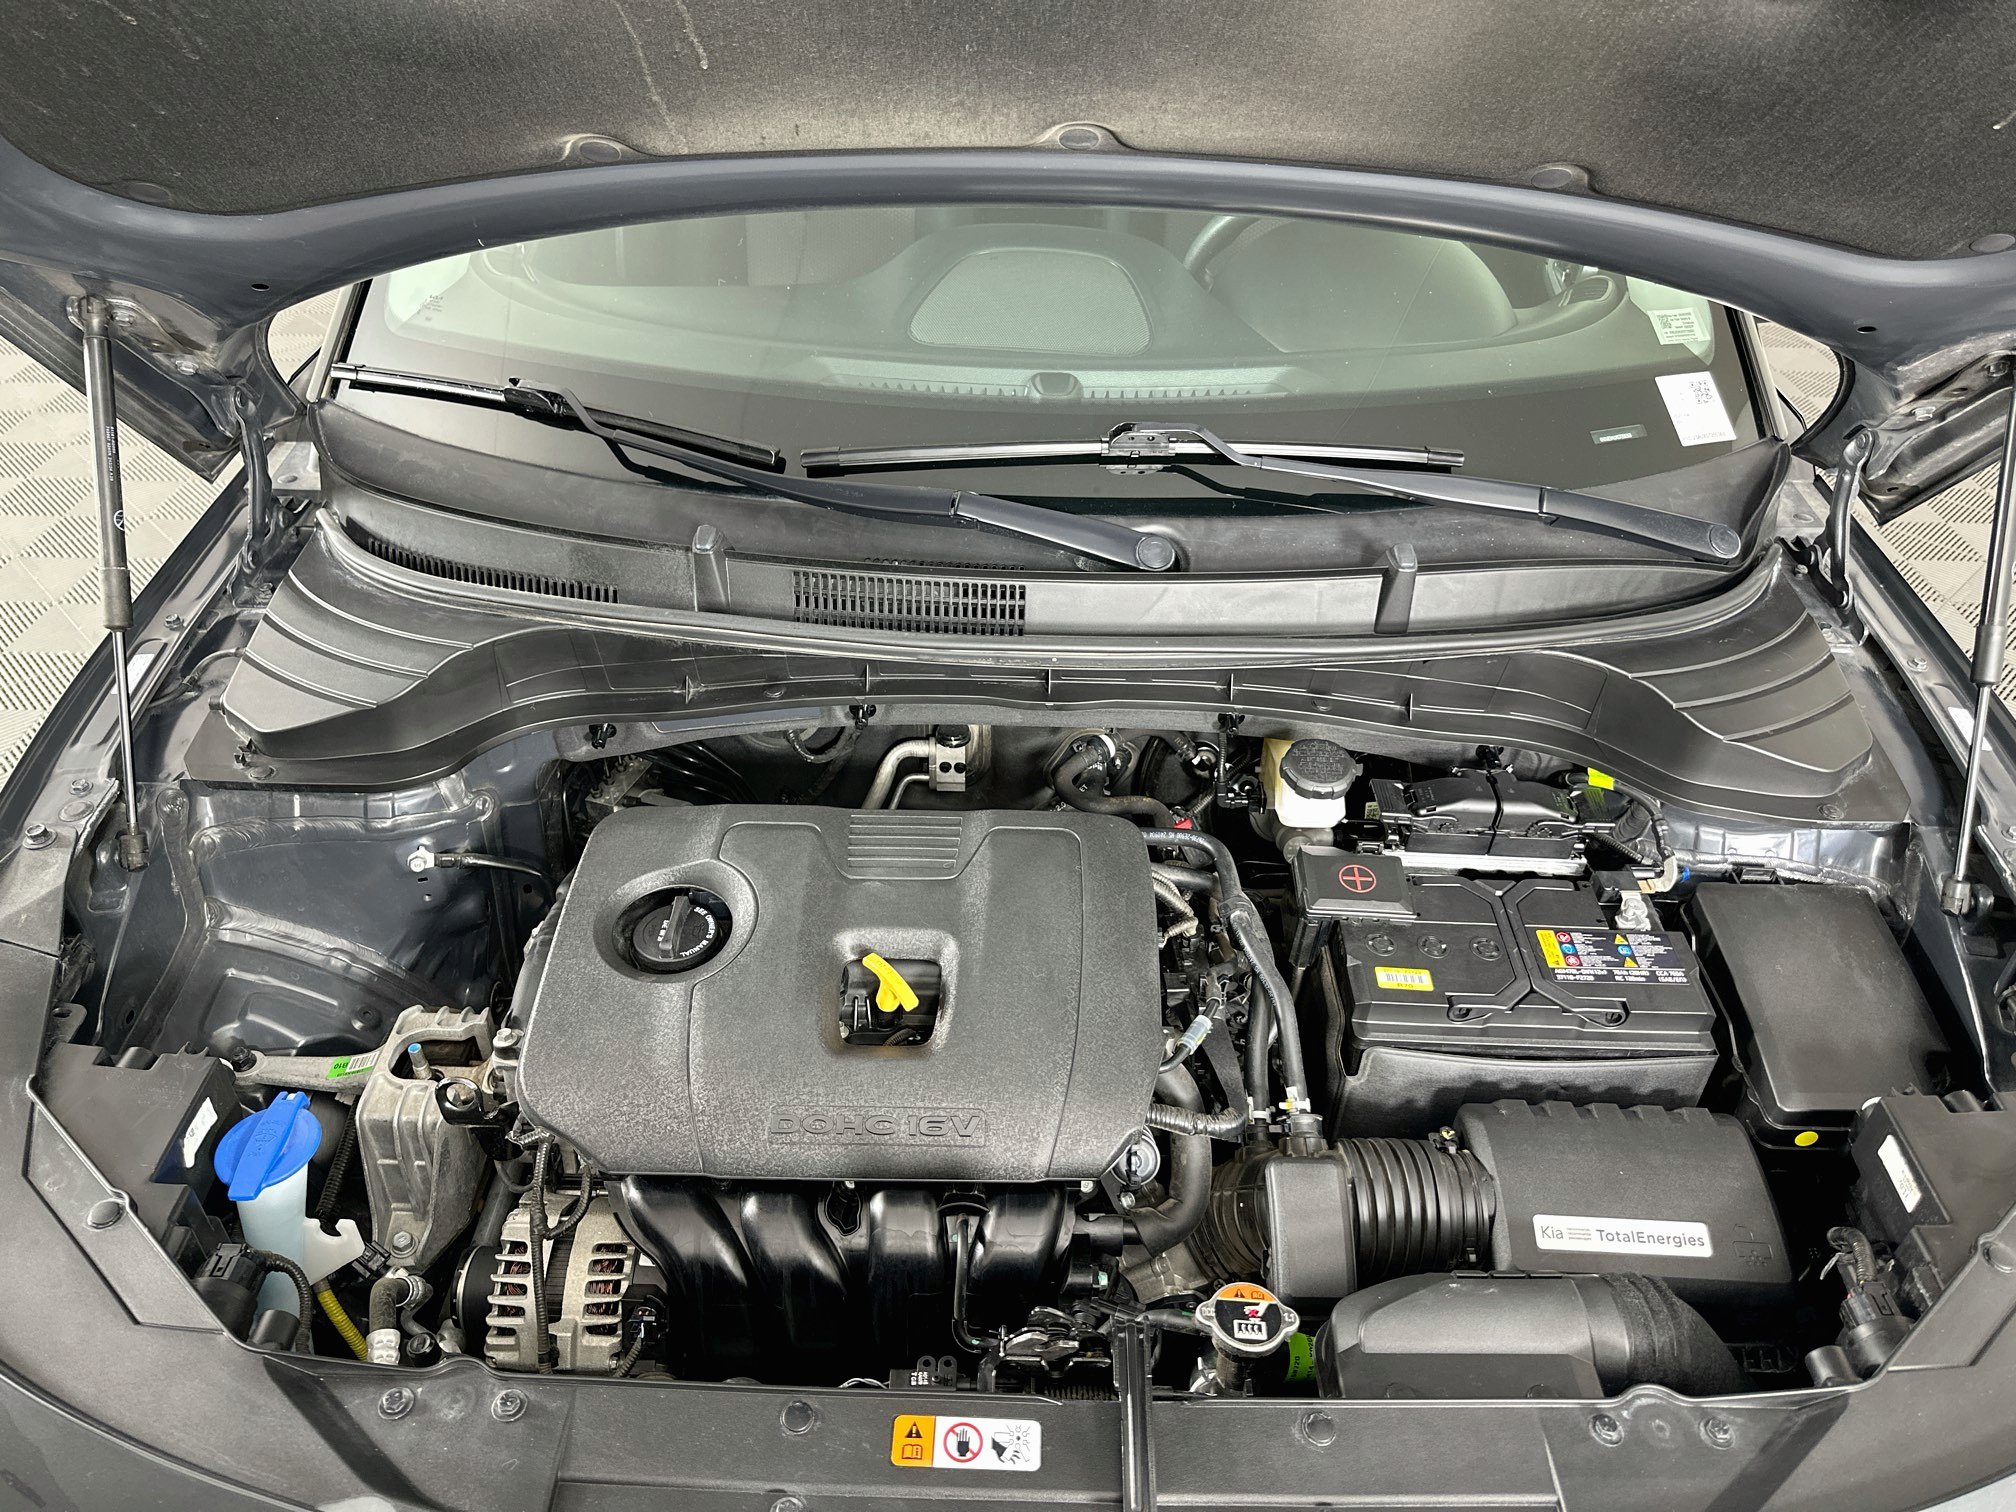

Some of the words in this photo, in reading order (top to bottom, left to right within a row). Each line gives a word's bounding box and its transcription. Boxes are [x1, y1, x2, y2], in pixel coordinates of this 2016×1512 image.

[693, 906, 707, 916] SEE
[680, 939, 709, 957] MANUAL
[770, 1114, 897, 1136] DOHC
[907, 1115, 980, 1138] 16V
[1540, 1225, 1564, 1239] Kia
[1596, 1229, 1705, 1248] TotalEnergies
[1283, 1312, 1295, 1322] 1.1
